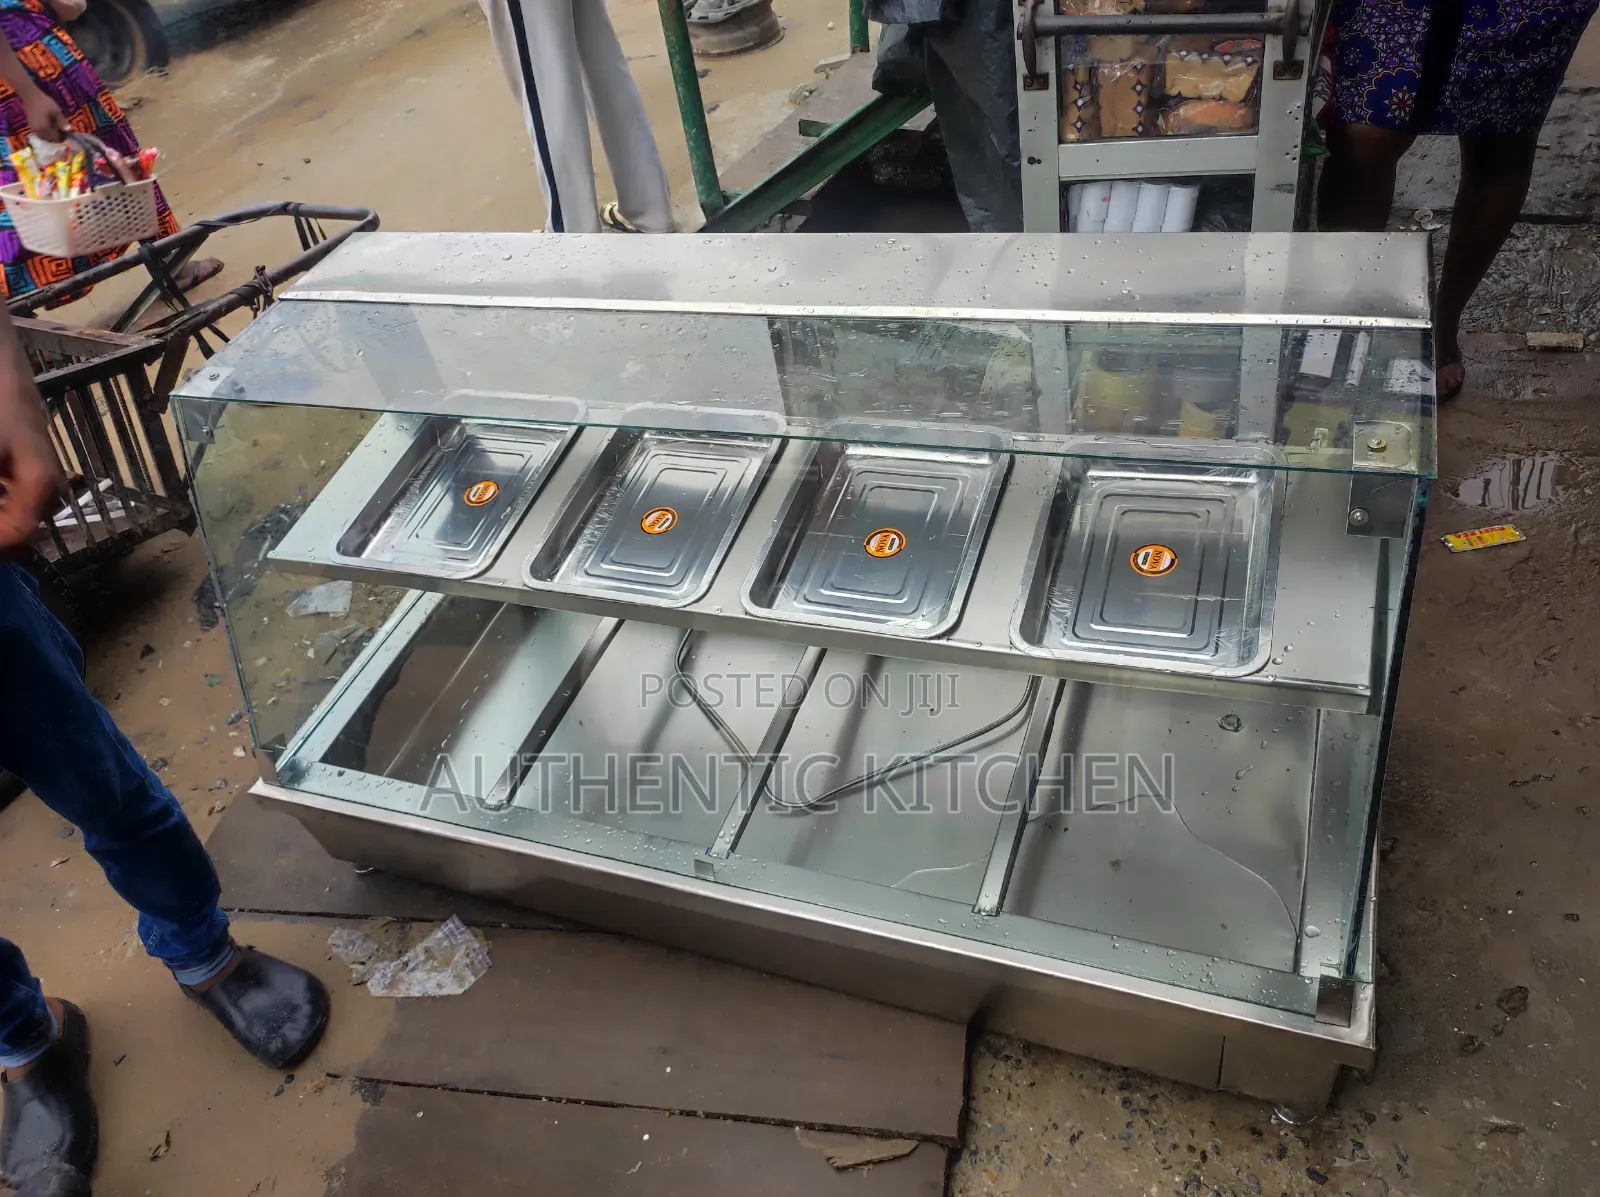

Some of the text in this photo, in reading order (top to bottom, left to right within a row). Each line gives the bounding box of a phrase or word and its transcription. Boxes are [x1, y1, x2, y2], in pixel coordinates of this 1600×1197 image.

[648, 513, 667, 528] NOVA
[876, 534, 890, 552] NOVA
[1149, 550, 1164, 569] NOVA
